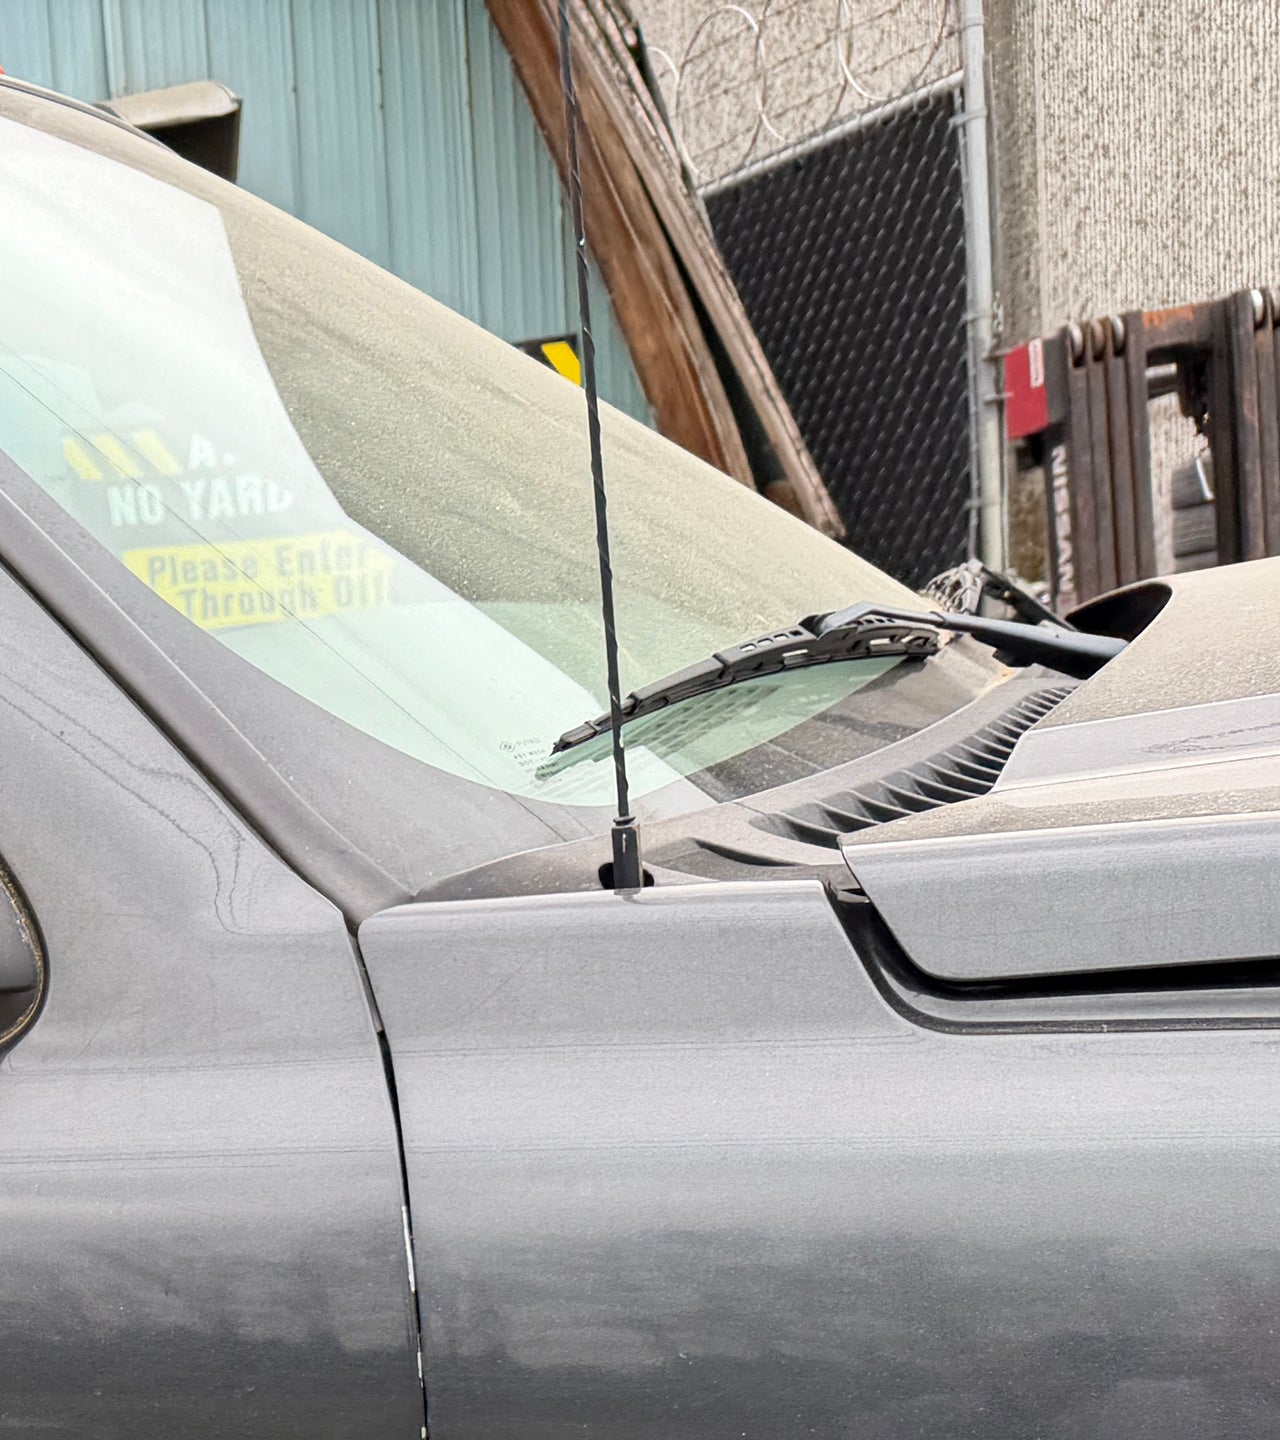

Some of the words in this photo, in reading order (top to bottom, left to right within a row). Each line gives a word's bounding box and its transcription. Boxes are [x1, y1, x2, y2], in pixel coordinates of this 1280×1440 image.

[106, 484, 166, 527] NO
[146, 550, 259, 587] Please
[275, 537, 370, 578] Enter
[177, 581, 319, 621] Through
